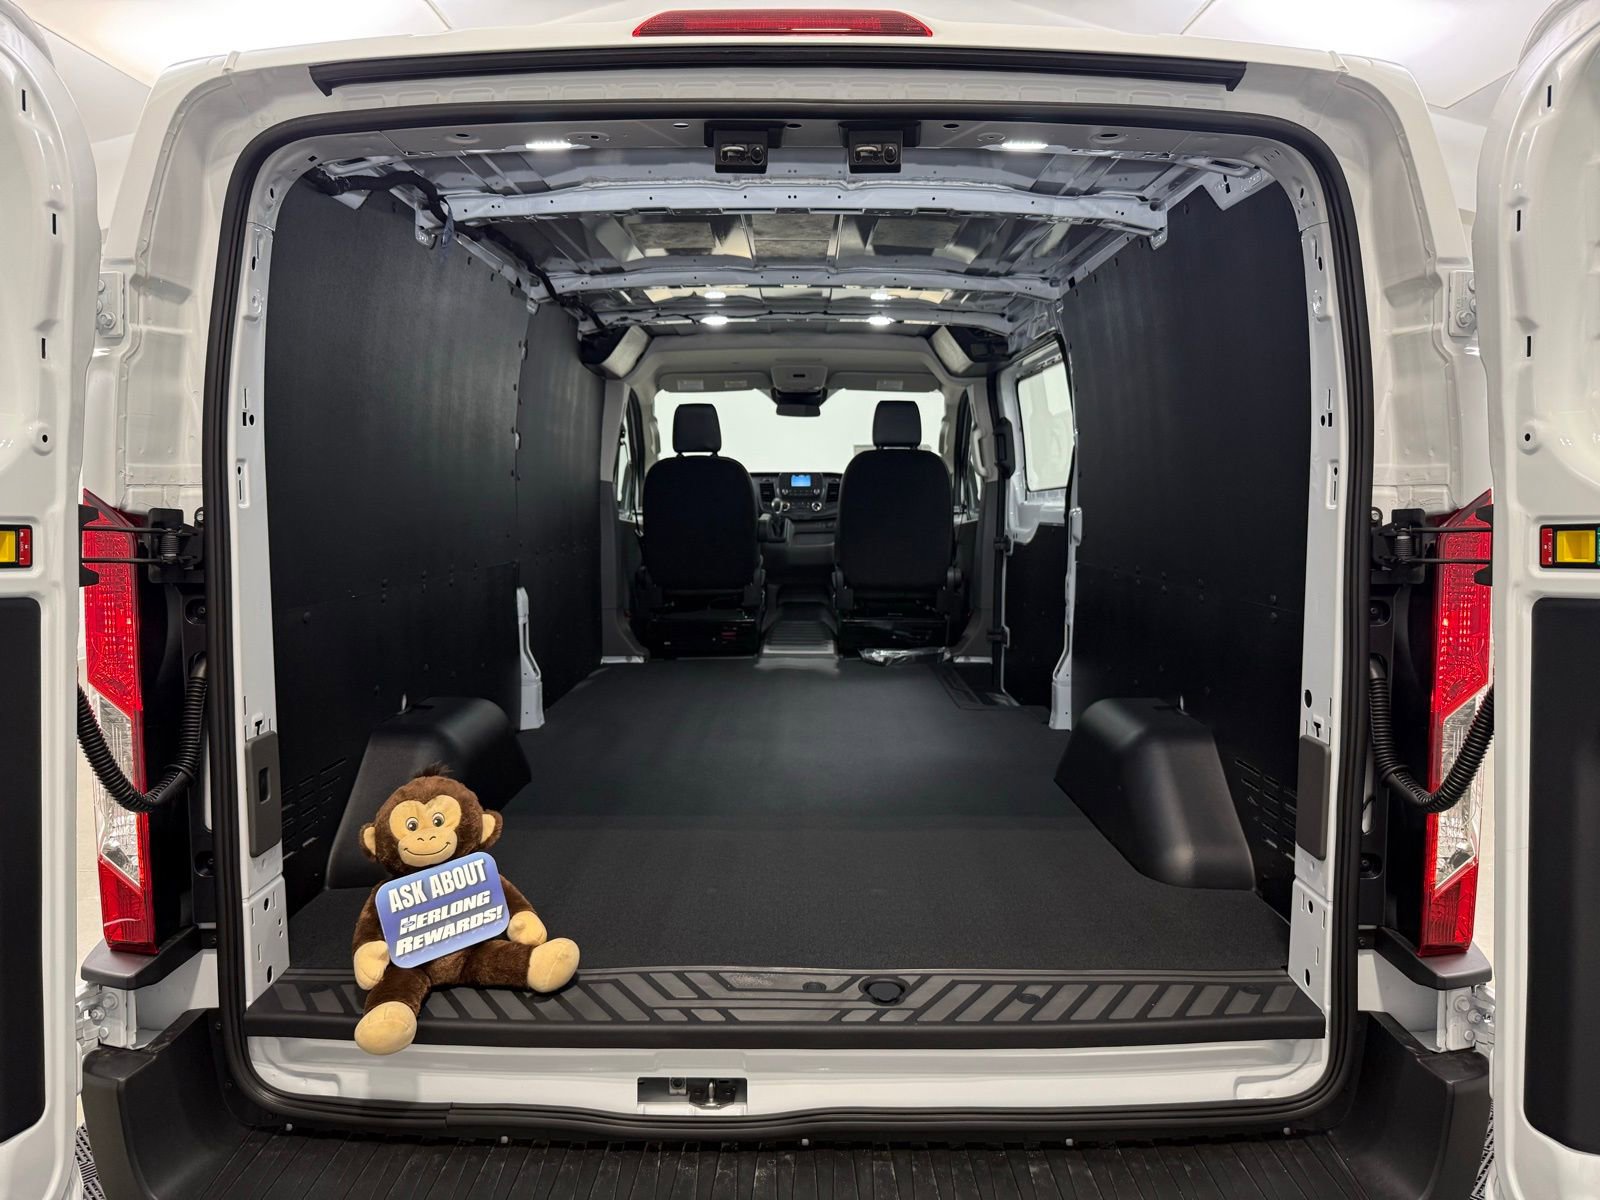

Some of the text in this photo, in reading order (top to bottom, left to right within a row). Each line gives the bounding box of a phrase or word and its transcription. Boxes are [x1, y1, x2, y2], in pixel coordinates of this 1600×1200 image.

[388, 858, 487, 914] ASK ABOUT
[395, 904, 504, 957] REWARDS!
[399, 890, 491, 936] HERLONG
